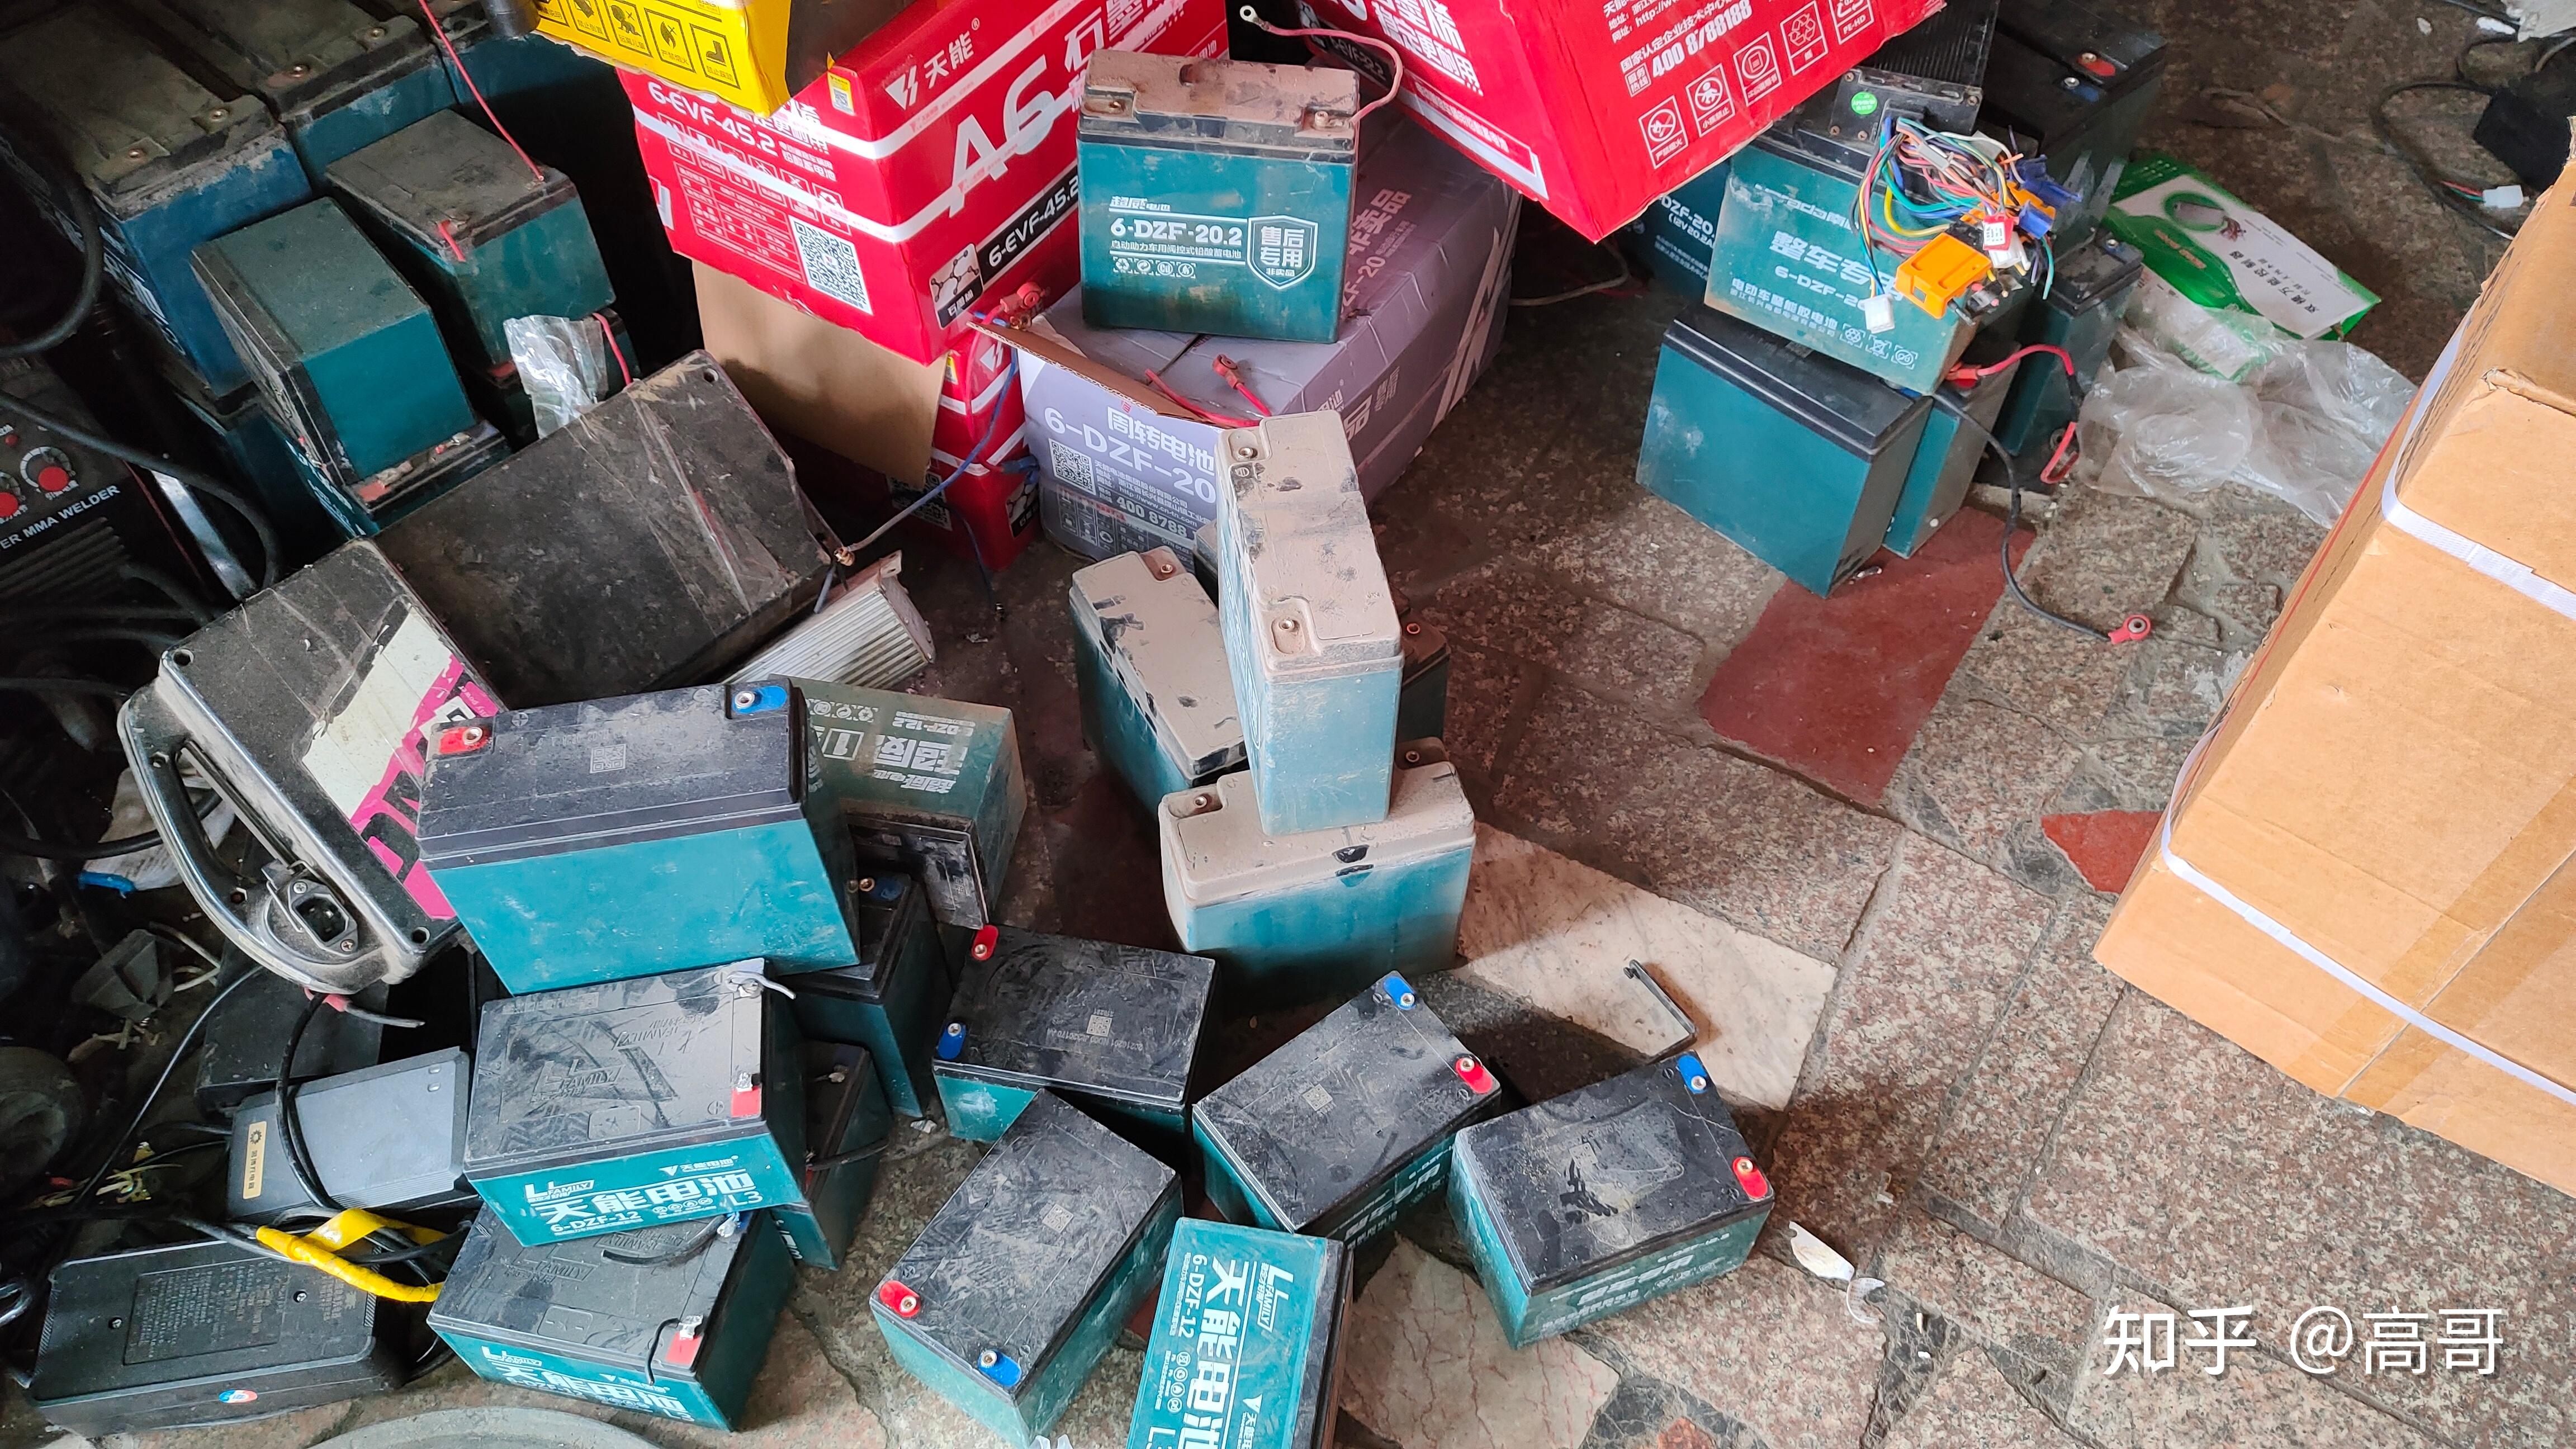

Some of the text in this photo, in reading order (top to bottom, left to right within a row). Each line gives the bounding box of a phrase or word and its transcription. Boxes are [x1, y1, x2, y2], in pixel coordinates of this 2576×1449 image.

[1620, 0, 1736, 73] 国家认定企业技术中心
[1843, 14, 1867, 35] PE-HD
[924, 31, 974, 89] 天能
[1371, 1, 1484, 97] 稳定更耐用
[1652, 42, 1685, 78] 400
[647, 81, 779, 157] 6-EVF-45.2
[988, 174, 1080, 268] 6-EVF-45.2
[1110, 217, 1243, 247] 6-DZF-20.2
[1260, 225, 1305, 248] 售后
[1260, 247, 1303, 269] 专用
[1266, 267, 1296, 278] 非卖品
[1107, 406, 1215, 477] 周转电池
[0, 484, 121, 551] ER MMA WELDER
[1117, 496, 1196, 541] 400 8788
[534, 1173, 756, 1225] 天能电池
[547, 1182, 589, 1196] FAMILY
[727, 1191, 764, 1206] L3
[550, 1210, 639, 1232] 6-DZF-12
[1177, 1253, 1208, 1339] 6-DZF-12
[1261, 1285, 1275, 1327] FAMILY
[1178, 1256, 1251, 1449] 天能电池
[496, 1365, 688, 1413] 天能电池
